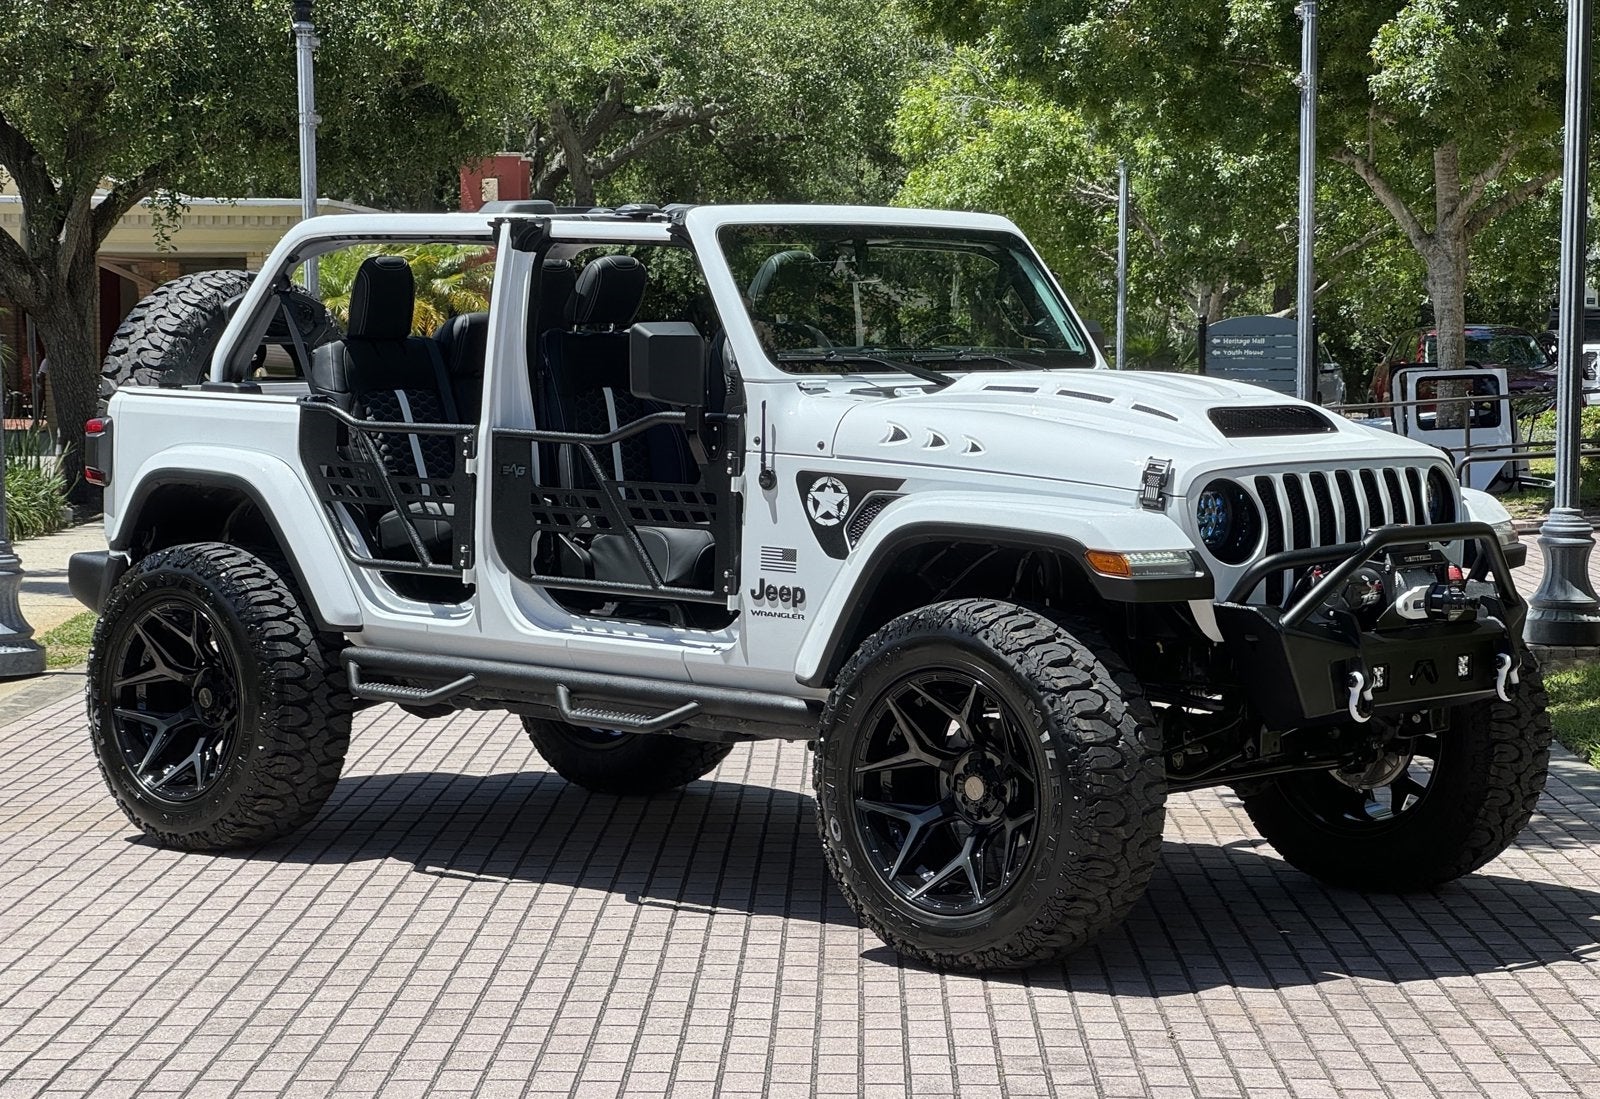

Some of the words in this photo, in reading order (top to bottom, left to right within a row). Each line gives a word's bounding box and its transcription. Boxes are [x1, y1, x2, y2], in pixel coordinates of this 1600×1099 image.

[1223, 338, 1250, 346] Heritage
[750, 577, 806, 608] Jeep
[750, 609, 806, 620] WRANGLER
[1023, 696, 1063, 905] MILESTAR
